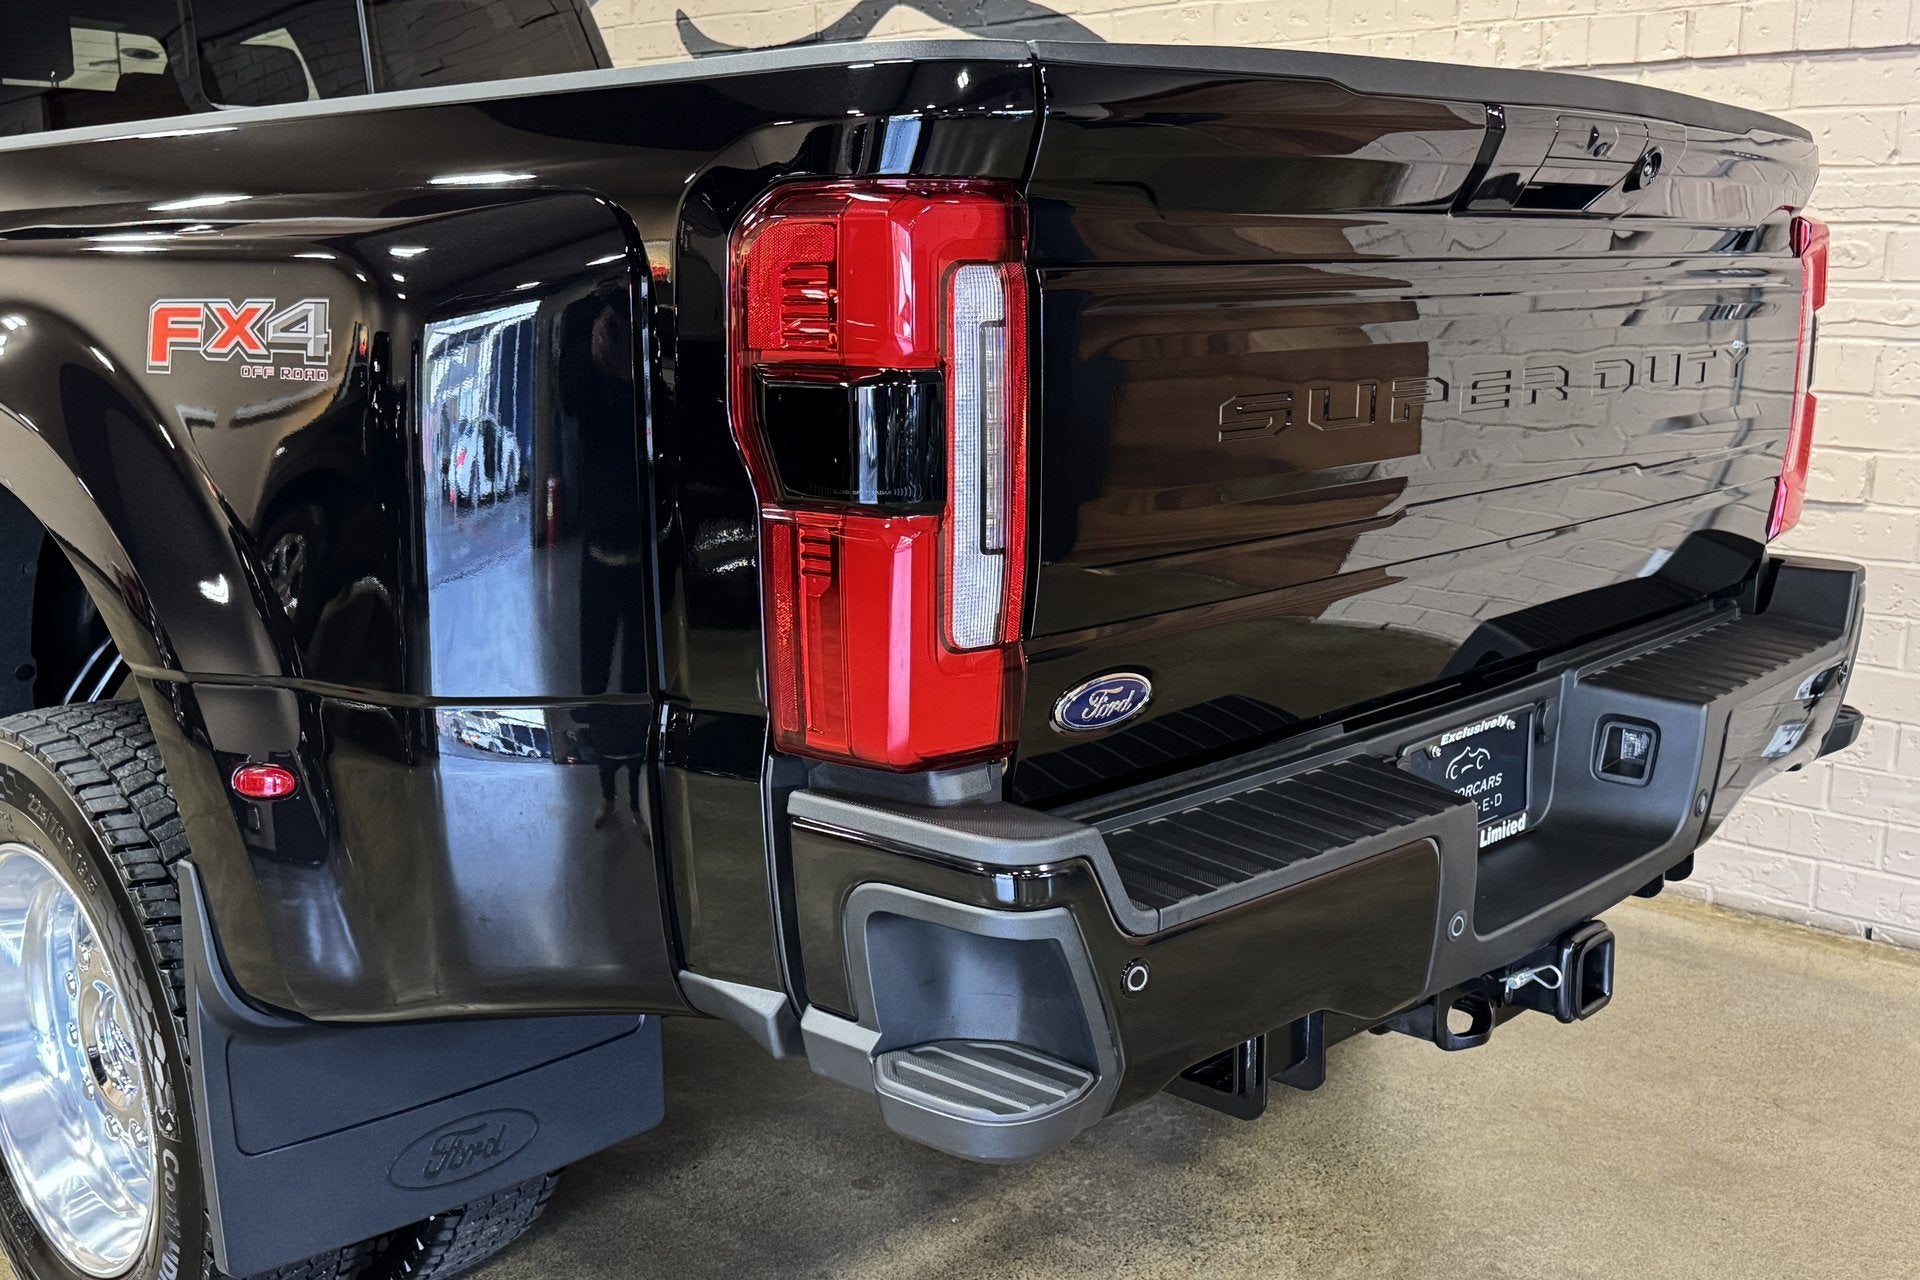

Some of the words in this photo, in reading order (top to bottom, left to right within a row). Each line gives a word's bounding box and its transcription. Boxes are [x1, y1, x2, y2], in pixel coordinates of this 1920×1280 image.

[146, 298, 332, 374] FX4
[240, 365, 275, 379] OFF
[280, 367, 329, 381] ROAD
[1218, 364, 1569, 442] SUPER
[1591, 346, 1749, 397] DUTY
[1081, 686, 1136, 722] Ford
[1440, 714, 1509, 747] Exclusively
[1454, 772, 1503, 797] ORCARS
[1479, 812, 1527, 849] Limited
[423, 1122, 507, 1179] Ford
[162, 1148, 182, 1239] Conti
[157, 1239, 181, 1280] HD
